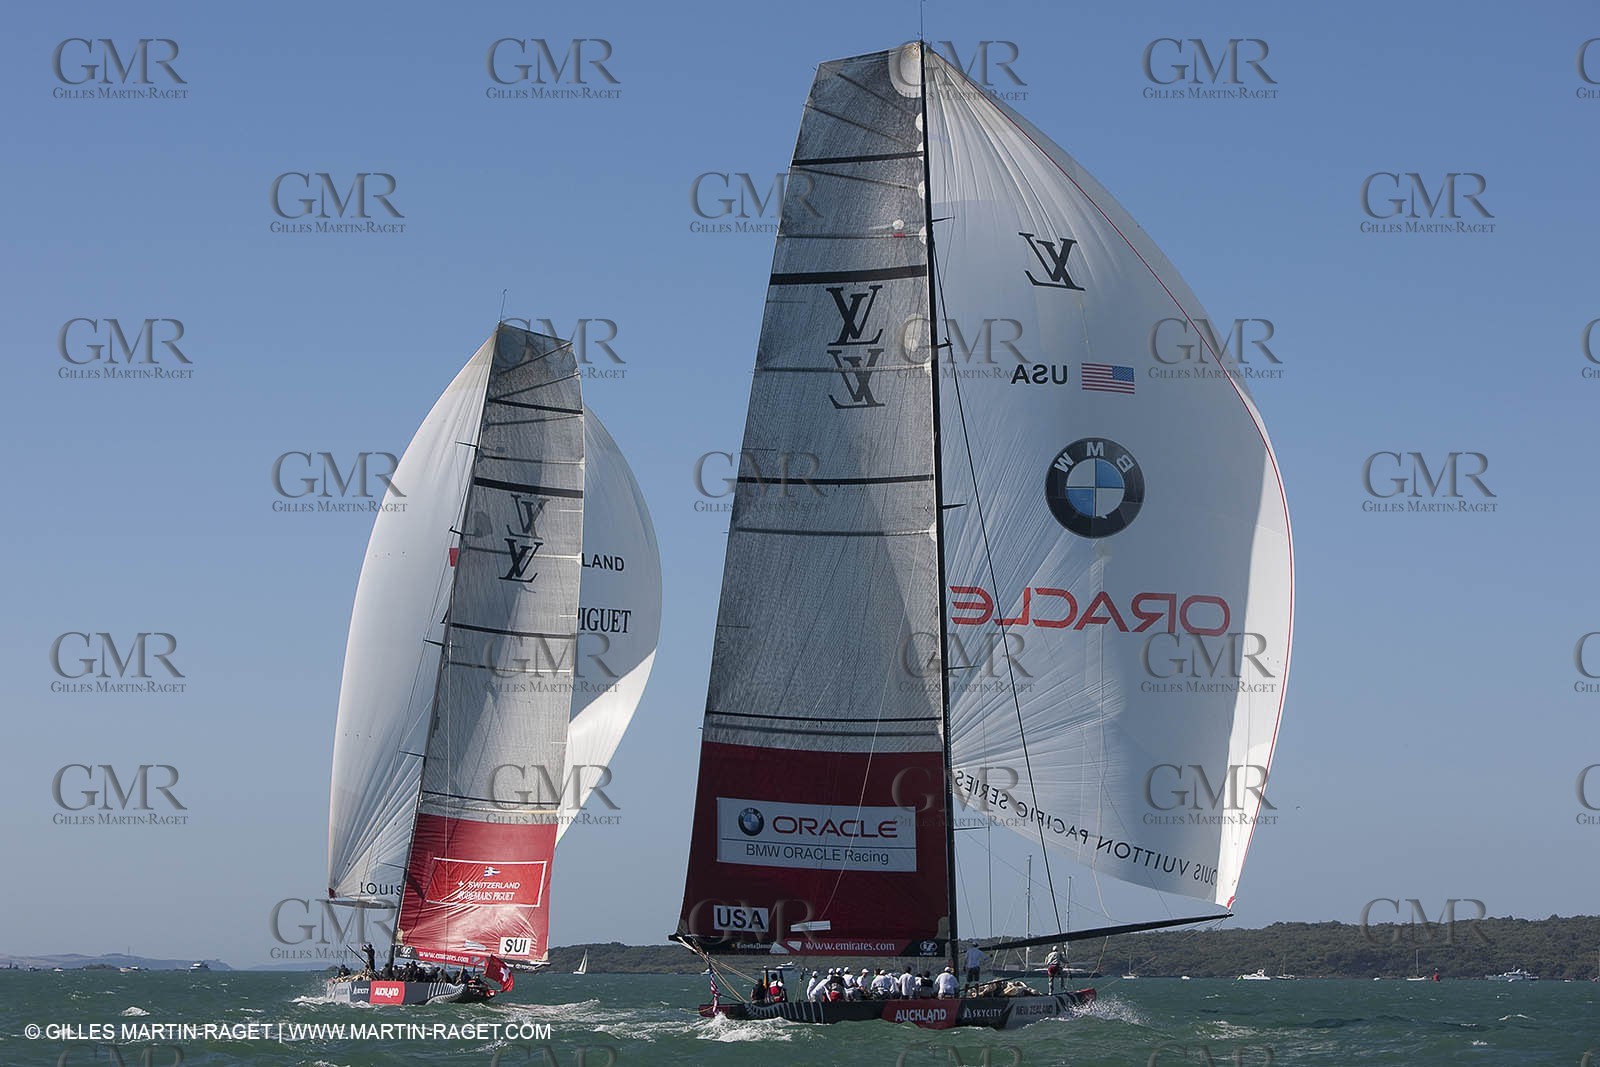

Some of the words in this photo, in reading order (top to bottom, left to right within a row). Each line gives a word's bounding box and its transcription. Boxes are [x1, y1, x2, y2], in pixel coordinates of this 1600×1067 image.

[576, 607, 632, 634] IGUET
[772, 815, 899, 838] ORACLE
[746, 843, 781, 858] BMW
[783, 846, 841, 862] ORACLE
[845, 849, 889, 866] Racing
[467, 881, 520, 889] SWITZERLAND
[717, 908, 765, 930] USA
[504, 938, 527, 953] SUI
[805, 941, 895, 951] www.emirates.com
[895, 1008, 947, 1023] AUCKLAND
[972, 1008, 1002, 1019] SKYCITY
